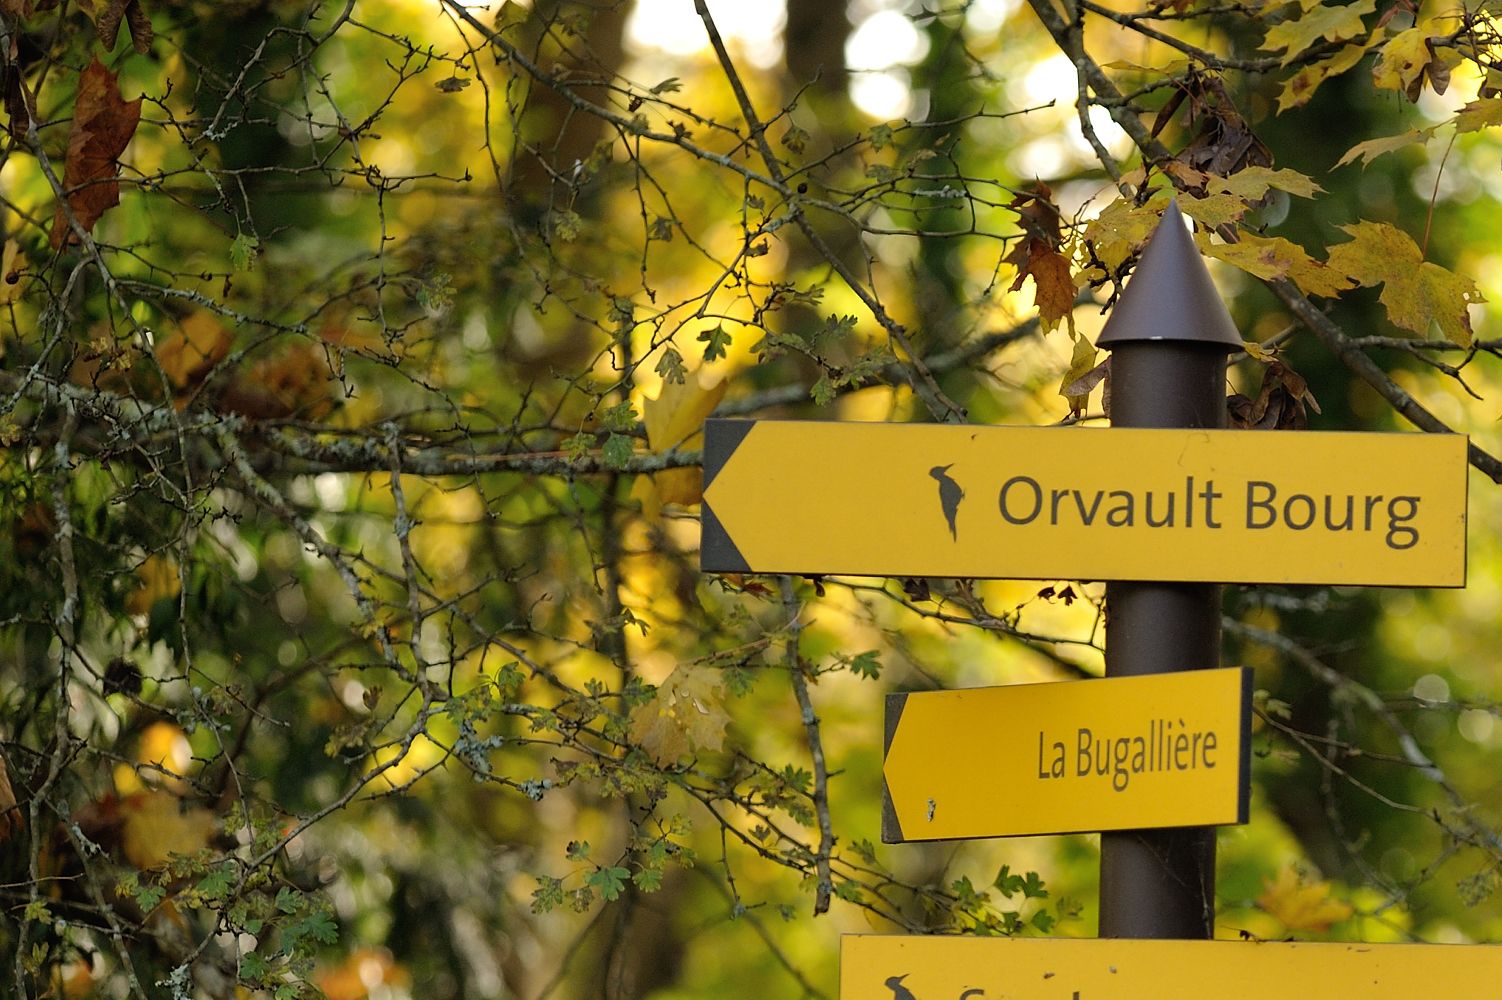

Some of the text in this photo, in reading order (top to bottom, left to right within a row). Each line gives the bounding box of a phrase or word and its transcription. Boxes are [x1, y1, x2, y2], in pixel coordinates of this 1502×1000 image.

[998, 475, 1421, 550] Orvault Bourg
[1038, 718, 1217, 792] La Bugallière
